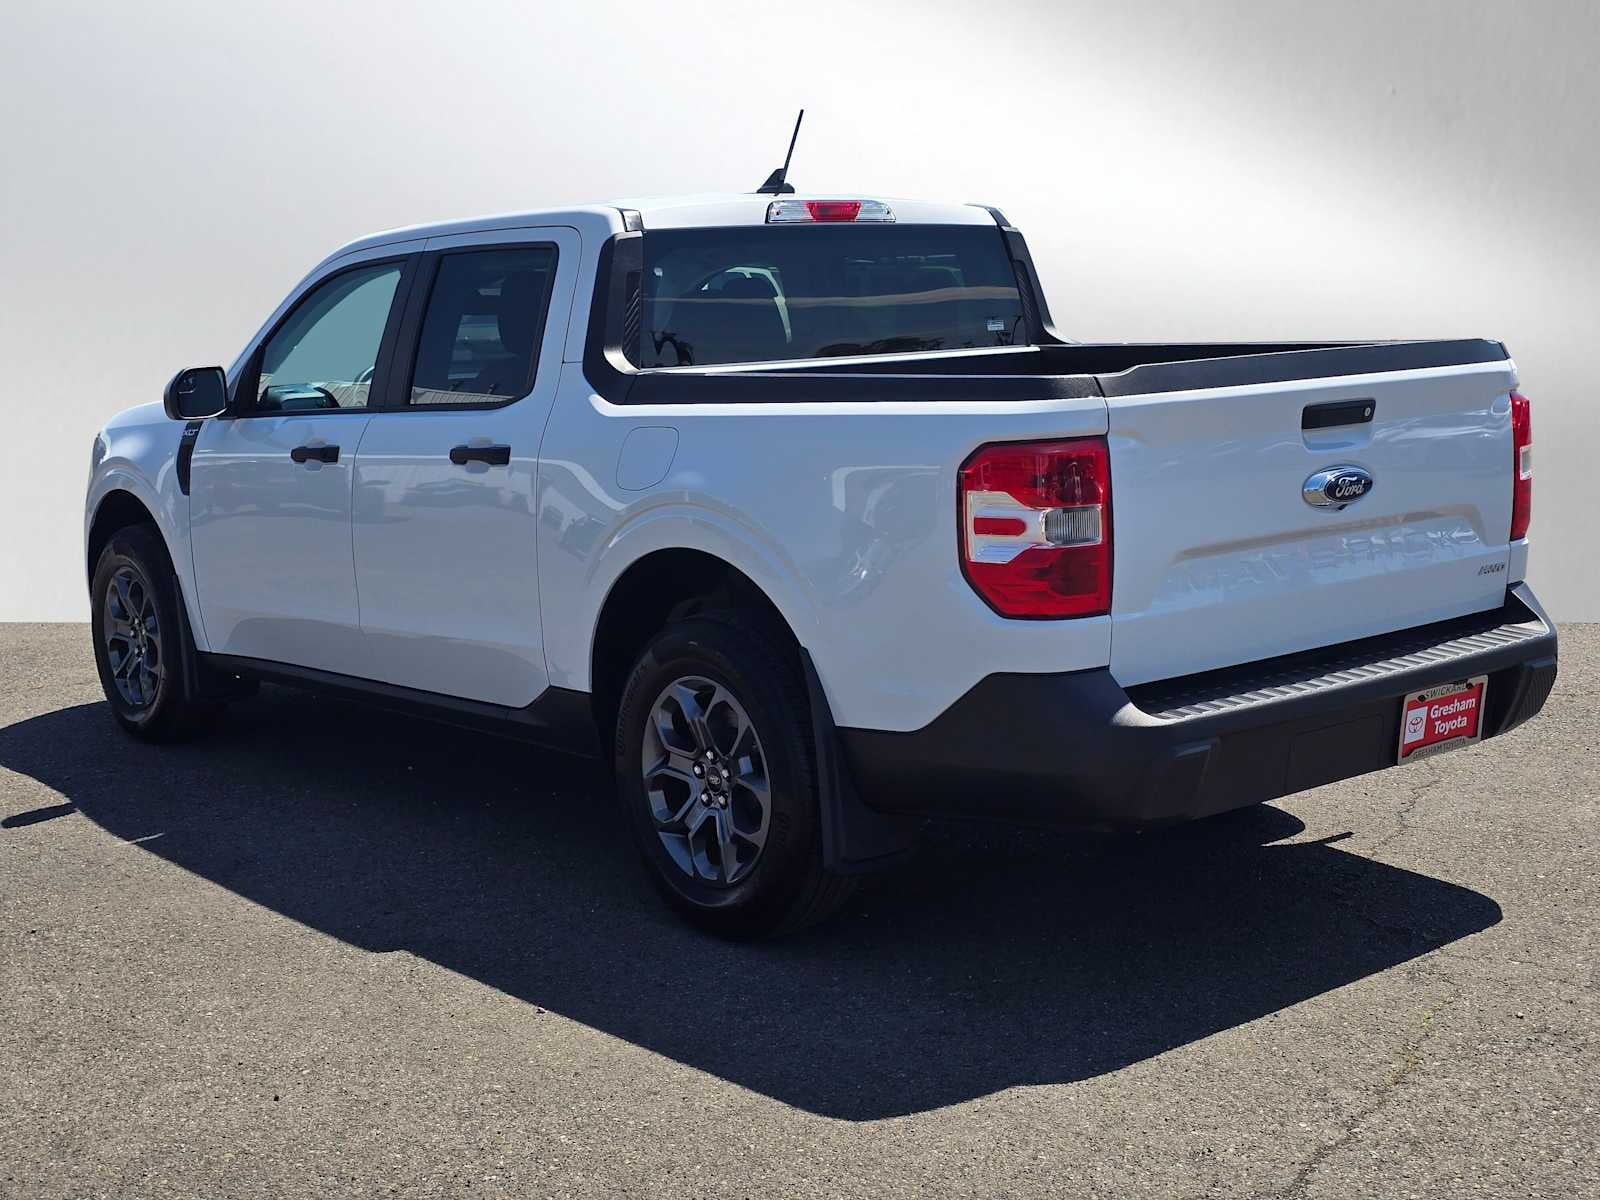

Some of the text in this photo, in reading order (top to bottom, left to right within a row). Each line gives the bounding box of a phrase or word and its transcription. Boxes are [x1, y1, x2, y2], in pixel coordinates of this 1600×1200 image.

[1335, 476, 1364, 497] Ford
[1430, 698, 1476, 719] Gresham
[1434, 716, 1468, 735] Toyota
